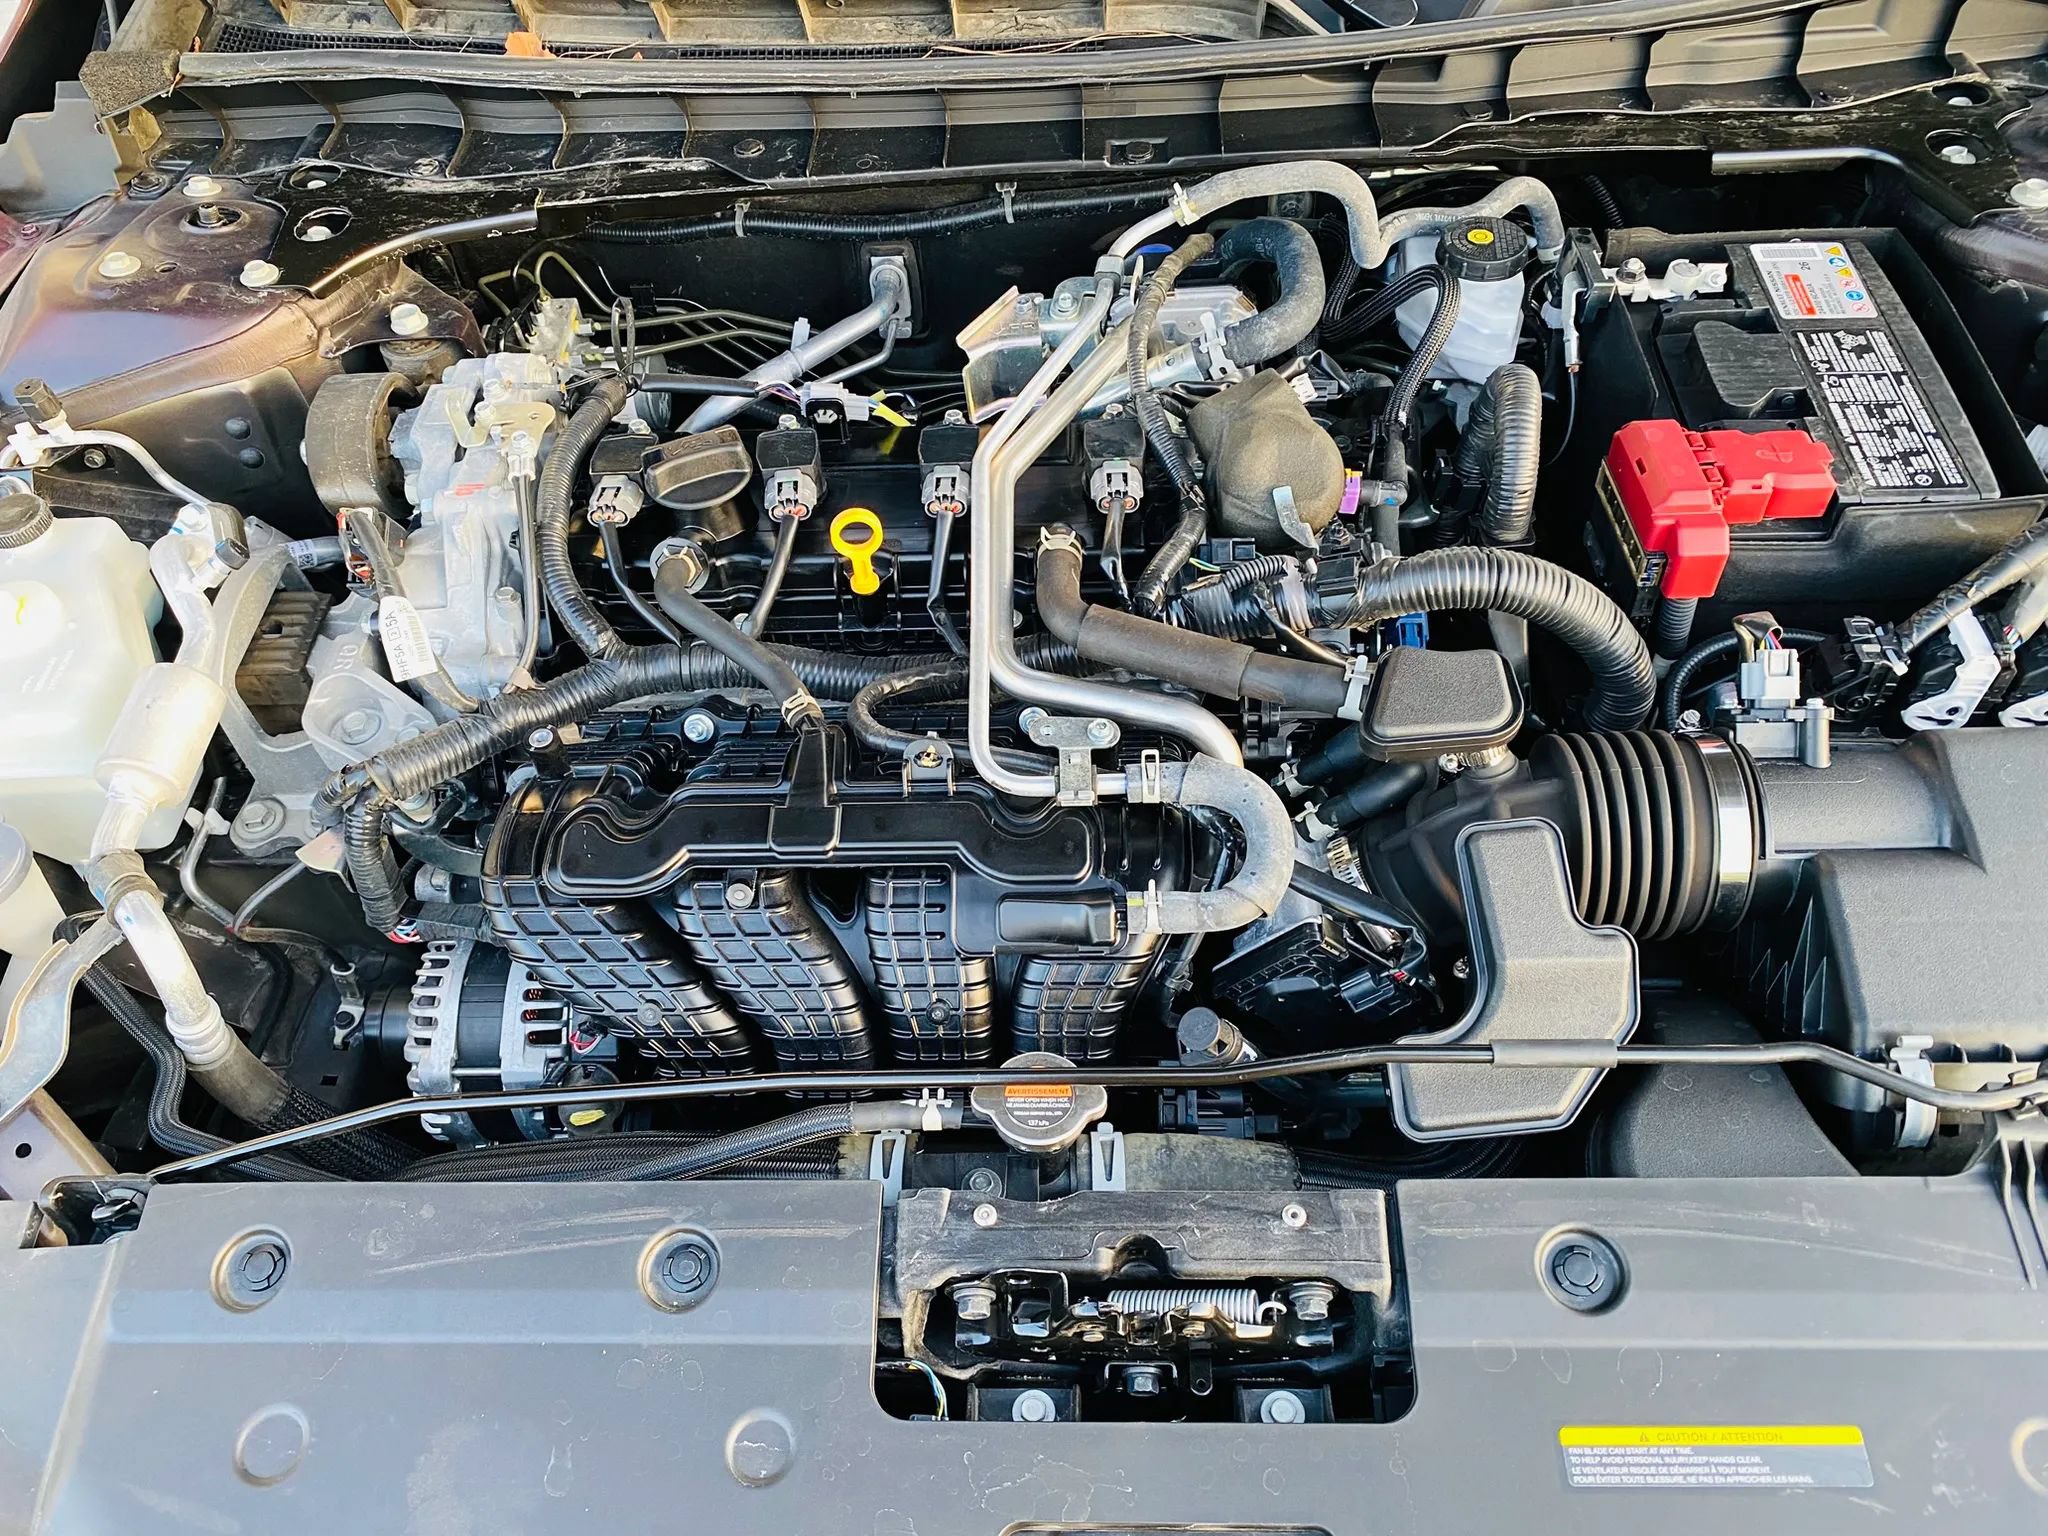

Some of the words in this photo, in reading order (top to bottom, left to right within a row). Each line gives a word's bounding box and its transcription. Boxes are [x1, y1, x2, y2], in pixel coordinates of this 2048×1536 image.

[1798, 261, 1811, 271] 26
[1766, 270, 1780, 292] NISSAN
[385, 610, 399, 628] 5A
[1656, 1431, 1707, 1442] CAUTION
[1720, 1431, 1784, 1442] ATTENTION
[1568, 1447, 1583, 1455] FAN
[1583, 1447, 1608, 1455] BLADE
[1609, 1447, 1625, 1455] CAN
[1626, 1447, 1648, 1455] START
[1659, 1447, 1674, 1455] ANY
[1570, 1456, 1580, 1464] TO
[1582, 1456, 1600, 1464] HELP
[1601, 1456, 1624, 1464] AVOID
[1624, 1456, 1664, 1464] PERSONAL
[1710, 1456, 1735, 1464] HANDS
[1572, 1467, 1582, 1475] LE
[1582, 1467, 1629, 1475] VENTILATEUR
[1630, 1467, 1657, 1475] RISQUE
[1658, 1466, 1669, 1475] DE
[1718, 1466, 1736, 1475] TOUT
[1573, 1476, 1595, 1484] POUR
[1621, 1476, 1645, 1484] TOUTE
[1699, 1476, 1714, 1484] PAS
[1715, 1476, 1726, 1484] EN
[1726, 1476, 1771, 1484] APPROCHER
[1772, 1476, 1788, 1484] LES
